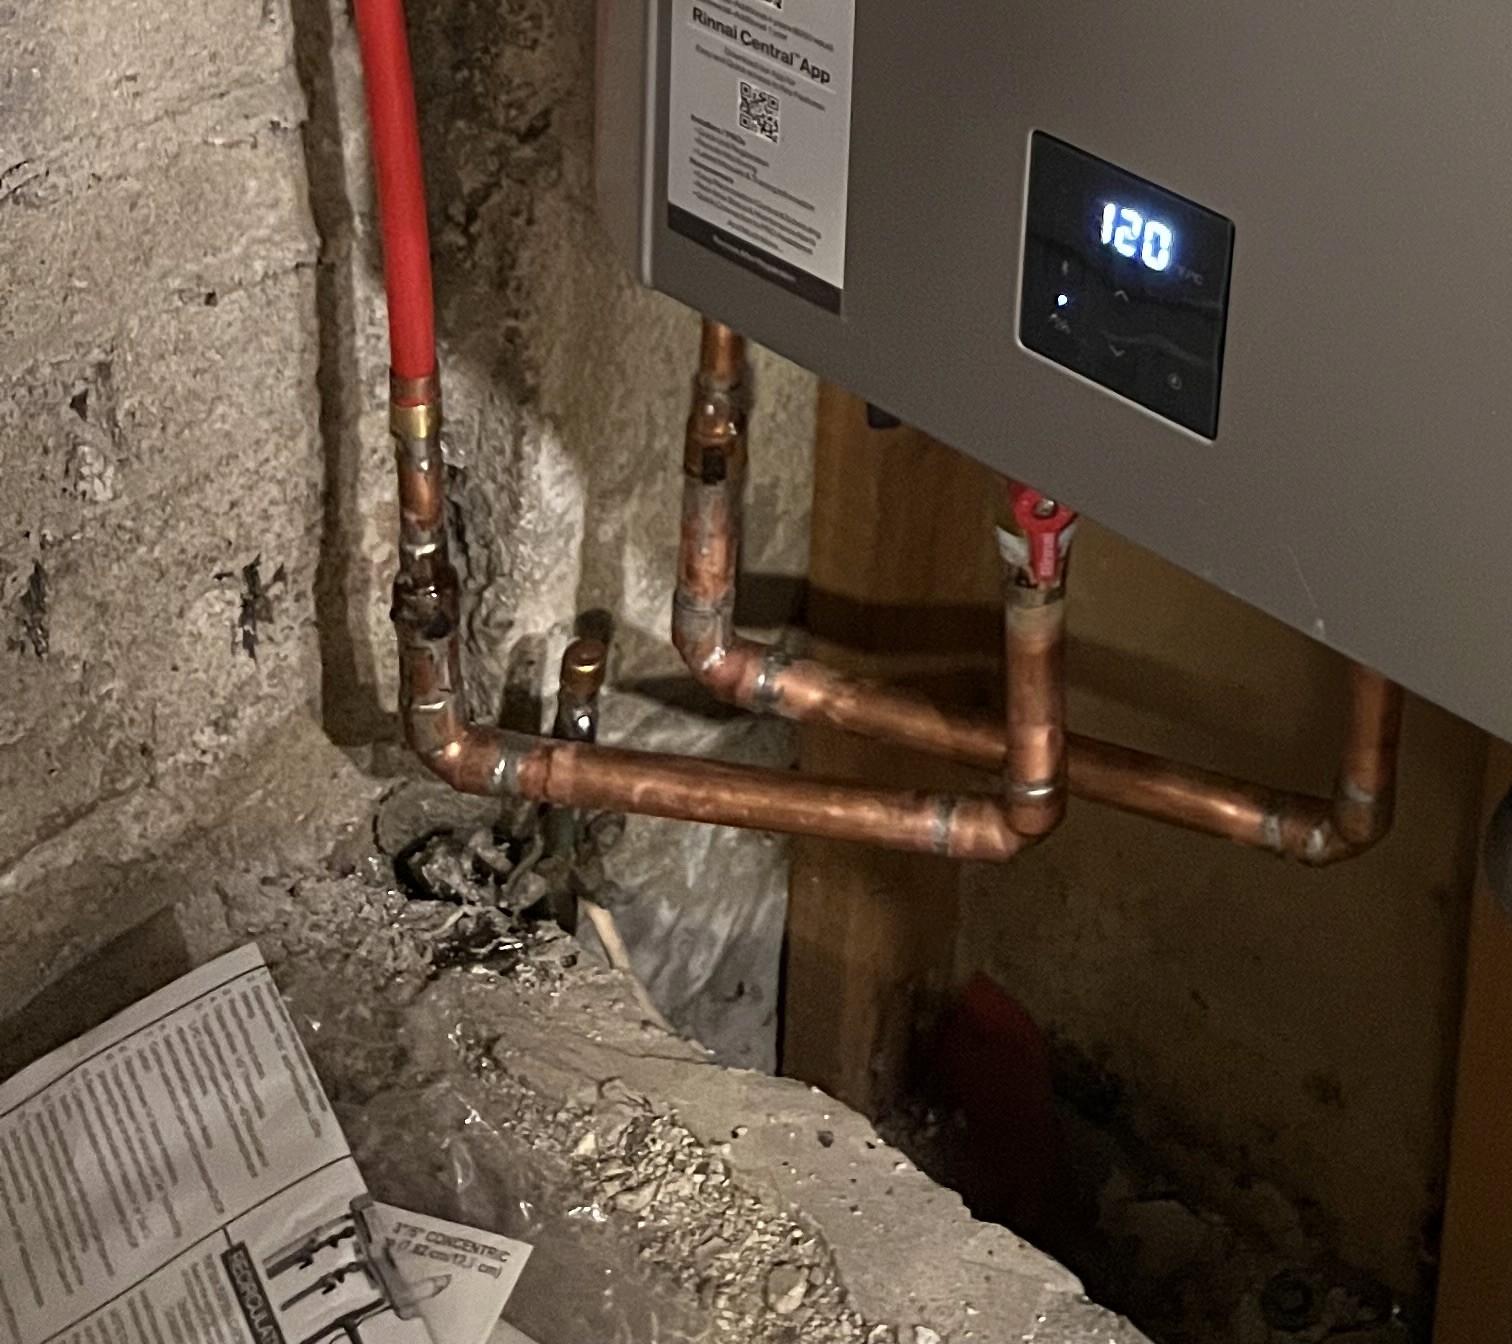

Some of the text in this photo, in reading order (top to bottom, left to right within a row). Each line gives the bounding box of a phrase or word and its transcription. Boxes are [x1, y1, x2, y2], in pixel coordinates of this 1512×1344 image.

[692, 6, 738, 40] Rinnai
[800, 58, 830, 84] App
[1099, 203, 1173, 272] 120
